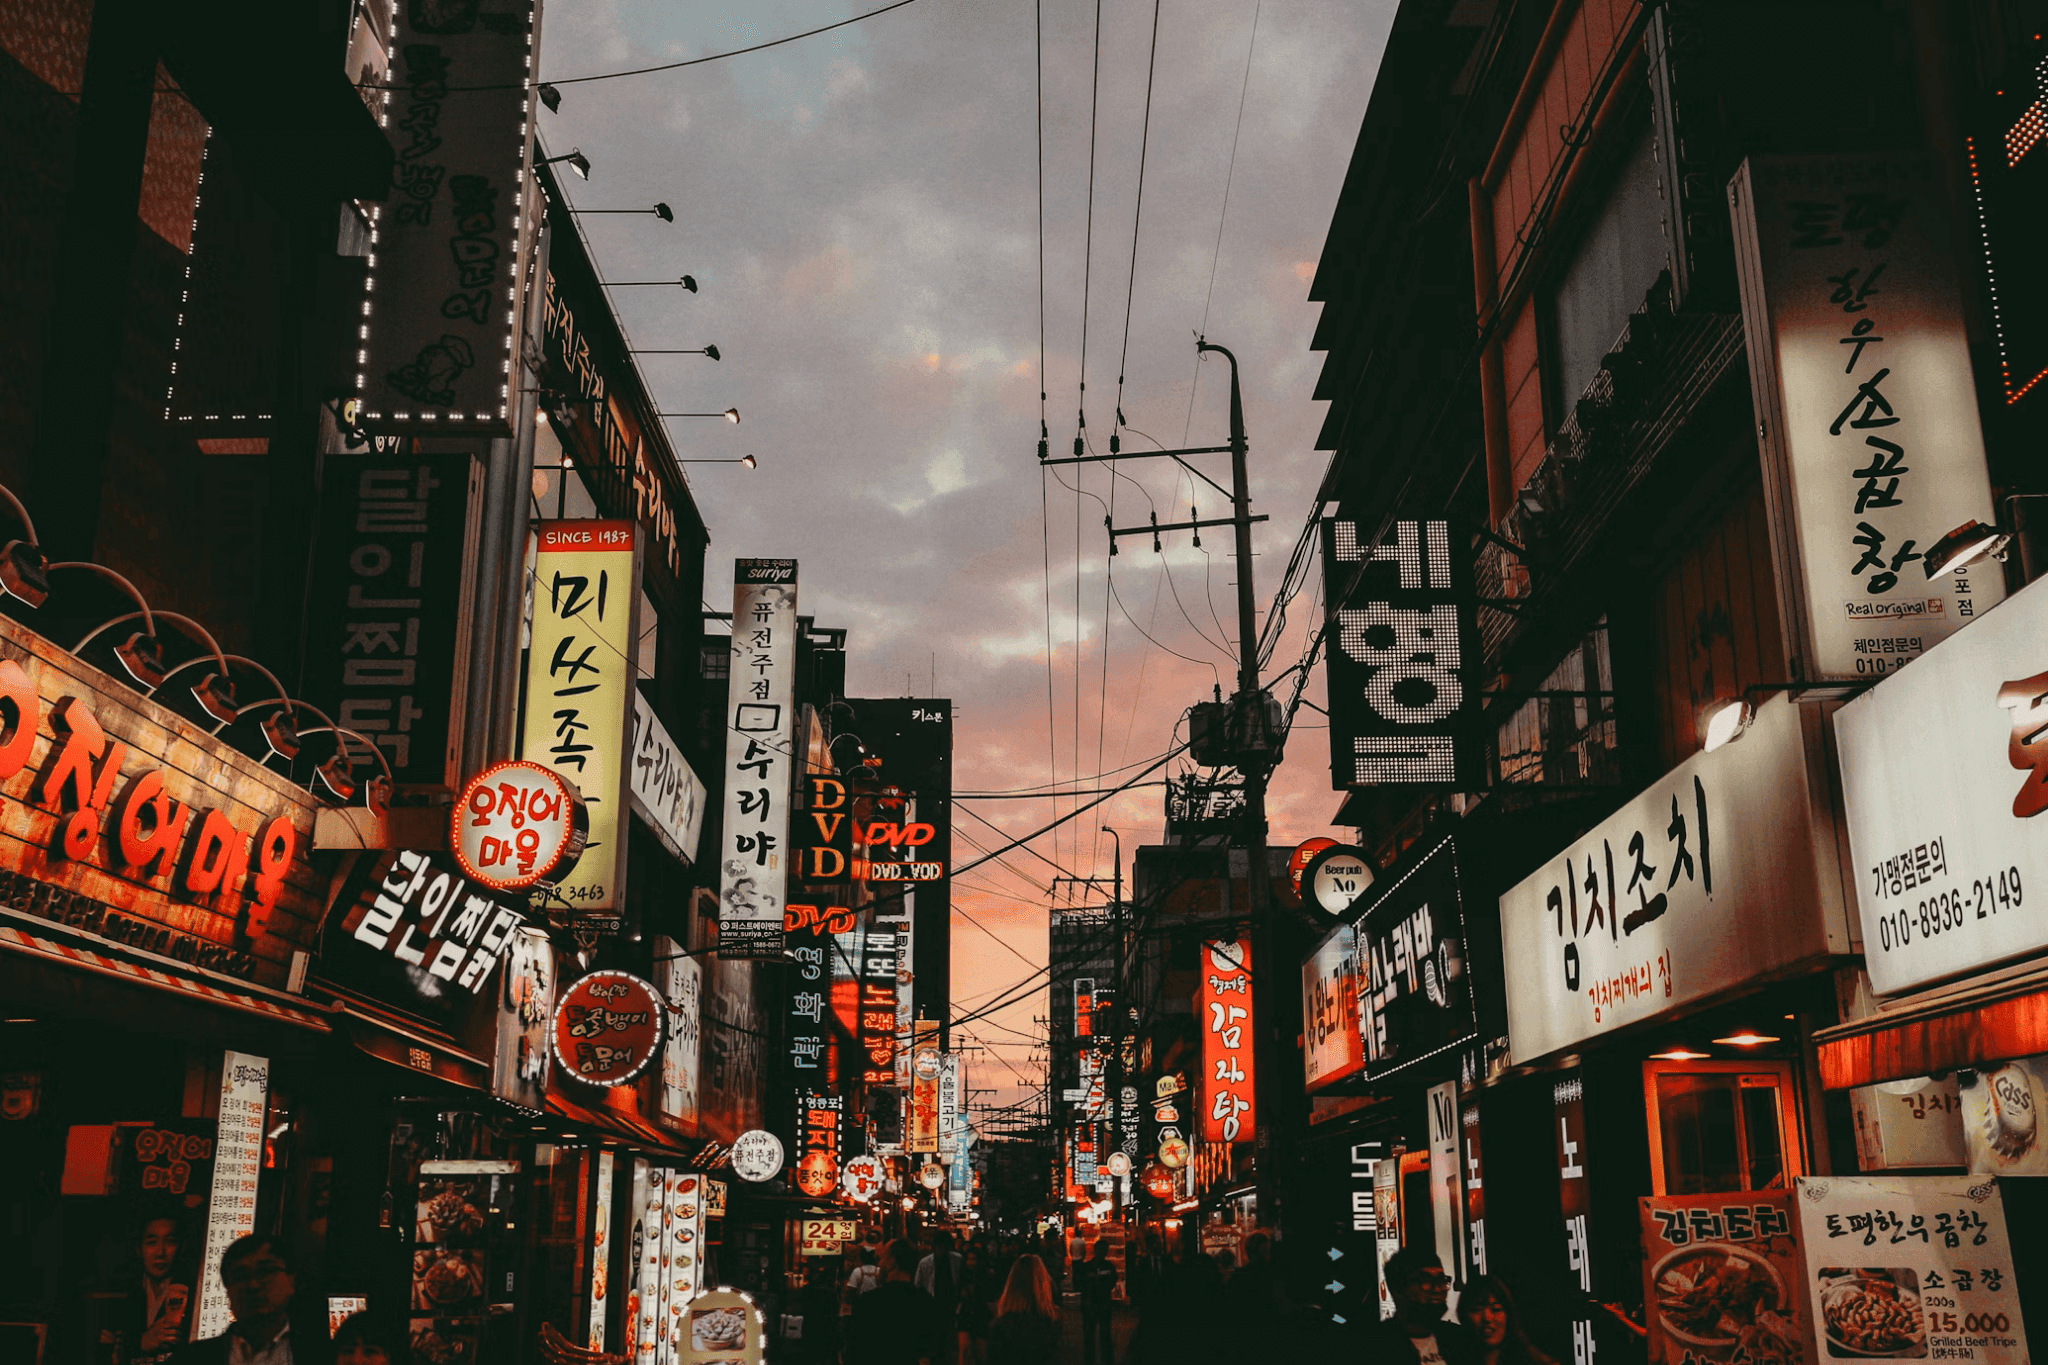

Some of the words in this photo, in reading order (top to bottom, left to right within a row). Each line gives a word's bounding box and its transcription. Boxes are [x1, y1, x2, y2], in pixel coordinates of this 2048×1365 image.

[546, 531, 592, 545] SINCE
[598, 530, 629, 544] 1987
[747, 565, 793, 582] suriya
[1845, 602, 1875, 616] Real
[750, 601, 775, 702] 퓨전주점
[1853, 636, 1923, 654] 체인점문의
[469, 782, 562, 829] 오징어
[734, 738, 777, 866] 수리야
[811, 778, 846, 877] DVD
[864, 822, 935, 846] DVD
[479, 828, 540, 876] 마을
[1872, 836, 1948, 900] 가맹점문의
[1325, 865, 1344, 875] Beer
[1346, 865, 1362, 875] pub
[1547, 775, 1713, 993] 김치조치
[569, 884, 605, 902] 3463
[1879, 865, 2023, 953] 010-8936-2149
[784, 904, 857, 937] DVD
[1208, 974, 1247, 995] 형제들
[1588, 960, 1653, 1024] 김치찌개의
[1658, 948, 1673, 998] 집
[1209, 1001, 1250, 1142] 감자탕
[806, 1097, 839, 1109] 영등포
[940, 1064, 956, 1129] 서울불고기
[1994, 1076, 2031, 1111] Cass
[134, 1128, 212, 1163] 오징어
[735, 1148, 775, 1163] 퓨전주점
[141, 1160, 192, 1194] 마을
[799, 1169, 836, 1185] 품앗이
[808, 1222, 836, 1239] 24
[1653, 1204, 1791, 1246] 김치조치
[1925, 1296, 1956, 1308] 200g
[1929, 1311, 2010, 1335] 15,000
[1930, 1336, 1963, 1347] Grilled
[1965, 1336, 1989, 1347] Beef
[1992, 1336, 2017, 1349] Tripe
